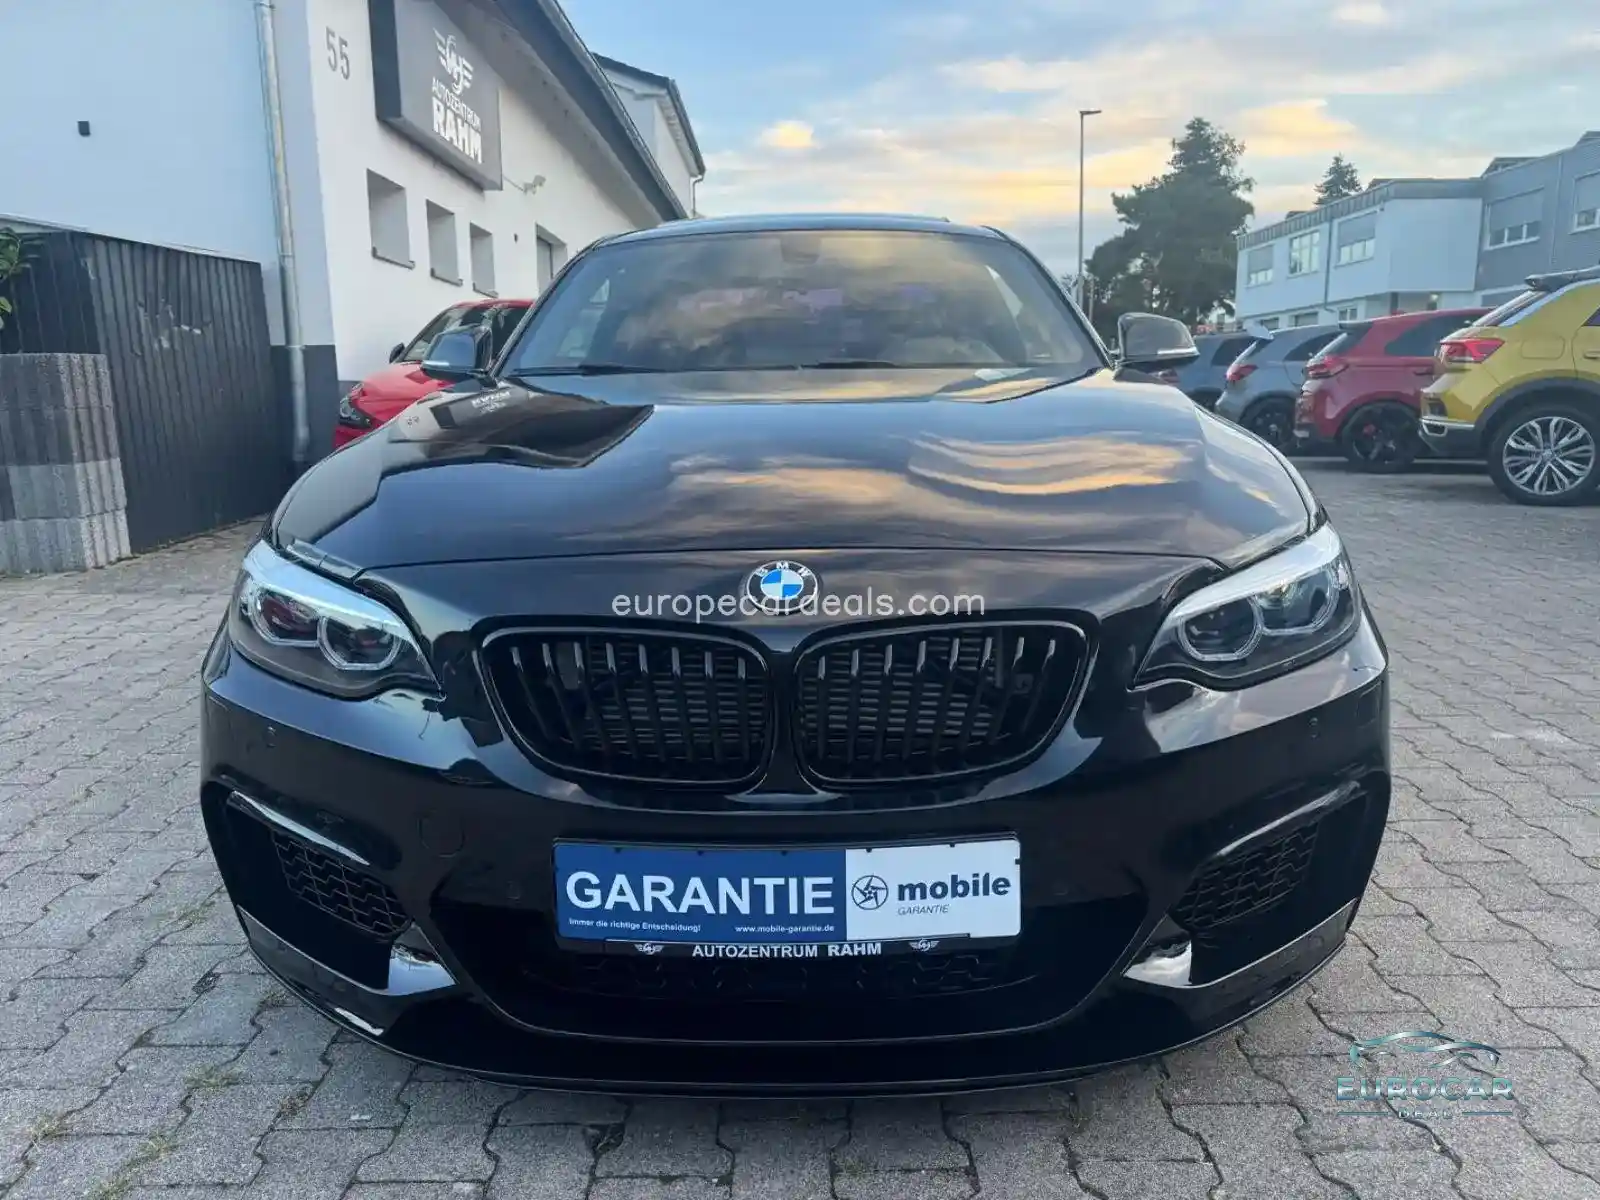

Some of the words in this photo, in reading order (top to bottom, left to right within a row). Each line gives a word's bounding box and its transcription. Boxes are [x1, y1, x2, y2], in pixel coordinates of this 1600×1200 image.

[326, 26, 350, 80] 55
[432, 76, 481, 132] AUTOZENTRUM
[432, 96, 482, 164] RAHM
[754, 561, 813, 578] BMW
[566, 871, 834, 915] GARANTIE
[897, 872, 1012, 902] mobile
[897, 903, 950, 916] GARANTIE
[569, 917, 594, 927] Immer
[596, 919, 608, 928] die
[610, 920, 641, 931] richtige
[642, 922, 701, 933] Entscheidung!
[735, 924, 835, 934] www.mobile-garantie.de
[692, 944, 818, 959] AUTOZENTRUM
[827, 942, 882, 957] RAHM
